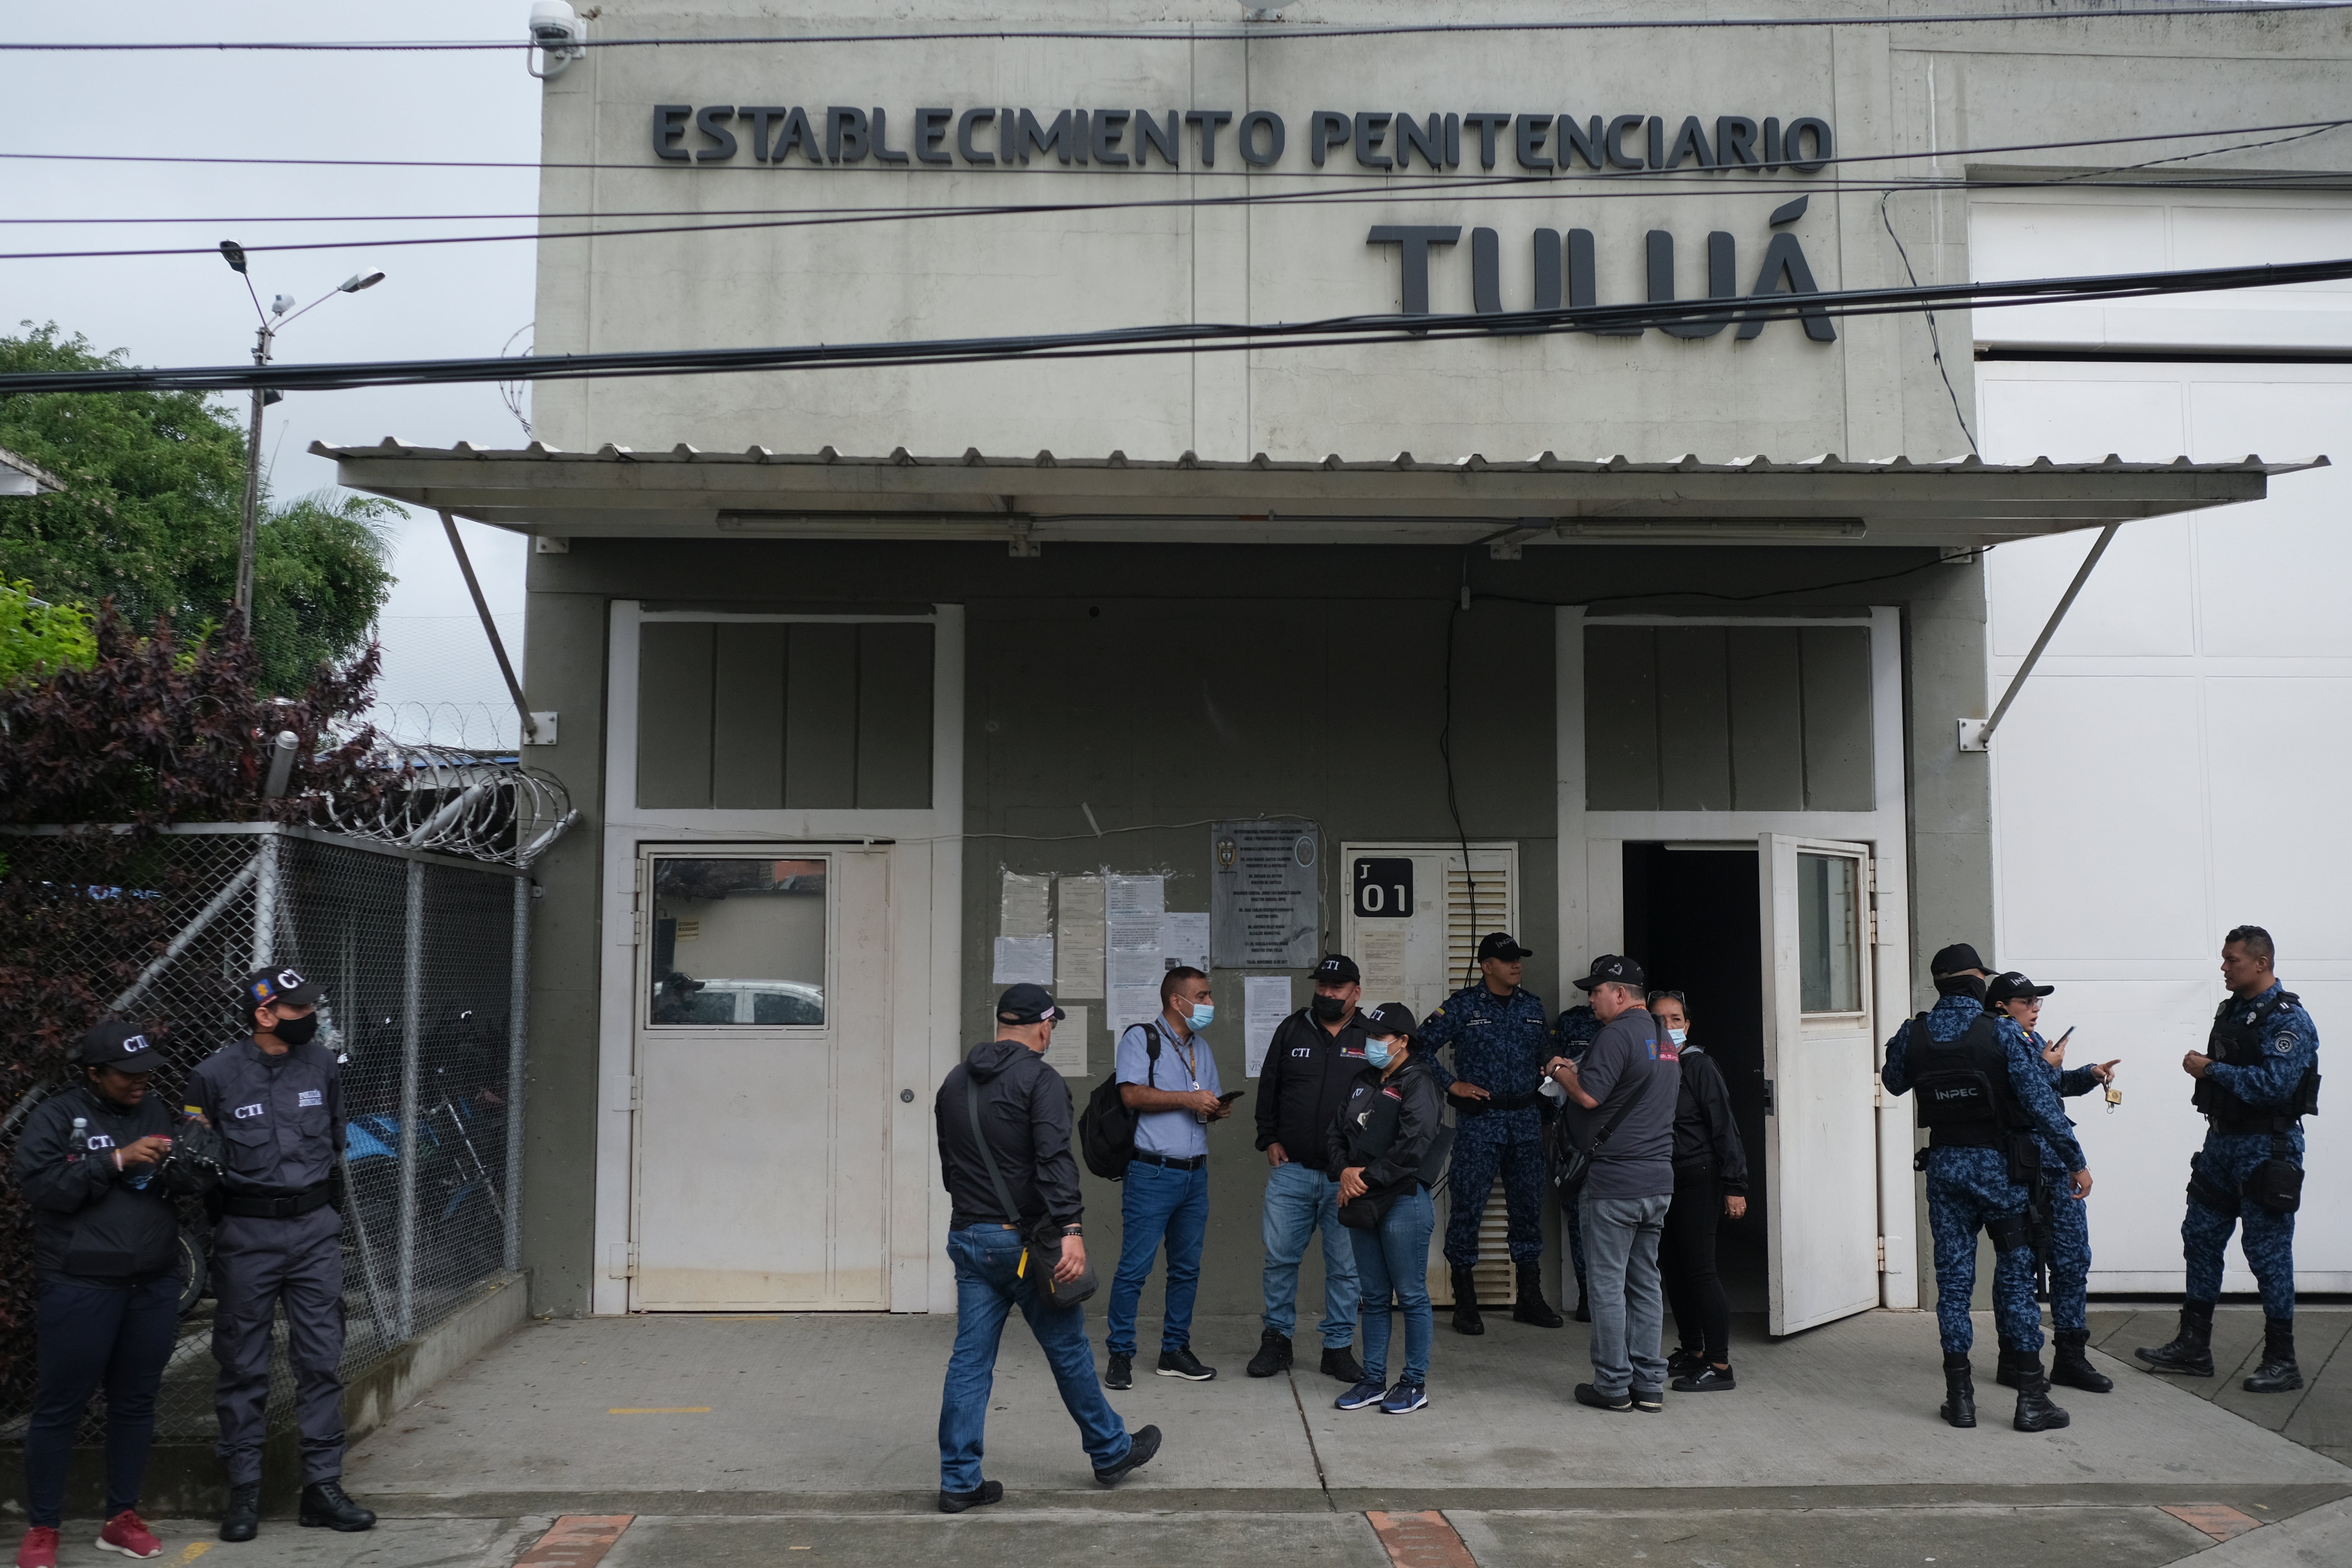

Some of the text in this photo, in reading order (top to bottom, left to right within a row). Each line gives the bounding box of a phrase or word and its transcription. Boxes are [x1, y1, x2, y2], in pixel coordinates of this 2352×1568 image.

[653, 104, 1832, 173] ESTABLECIMIENTO PENITENCIARIO
[1367, 194, 1837, 343] TULUÁ
[1360, 864, 1371, 879] J
[1363, 884, 1405, 912] 01
[1370, 1010, 1385, 1021] TI
[123, 1035, 149, 1052] CTI
[1292, 1048, 1310, 1057] CTI
[235, 1103, 264, 1119] CTI
[88, 1135, 115, 1150] CTI
